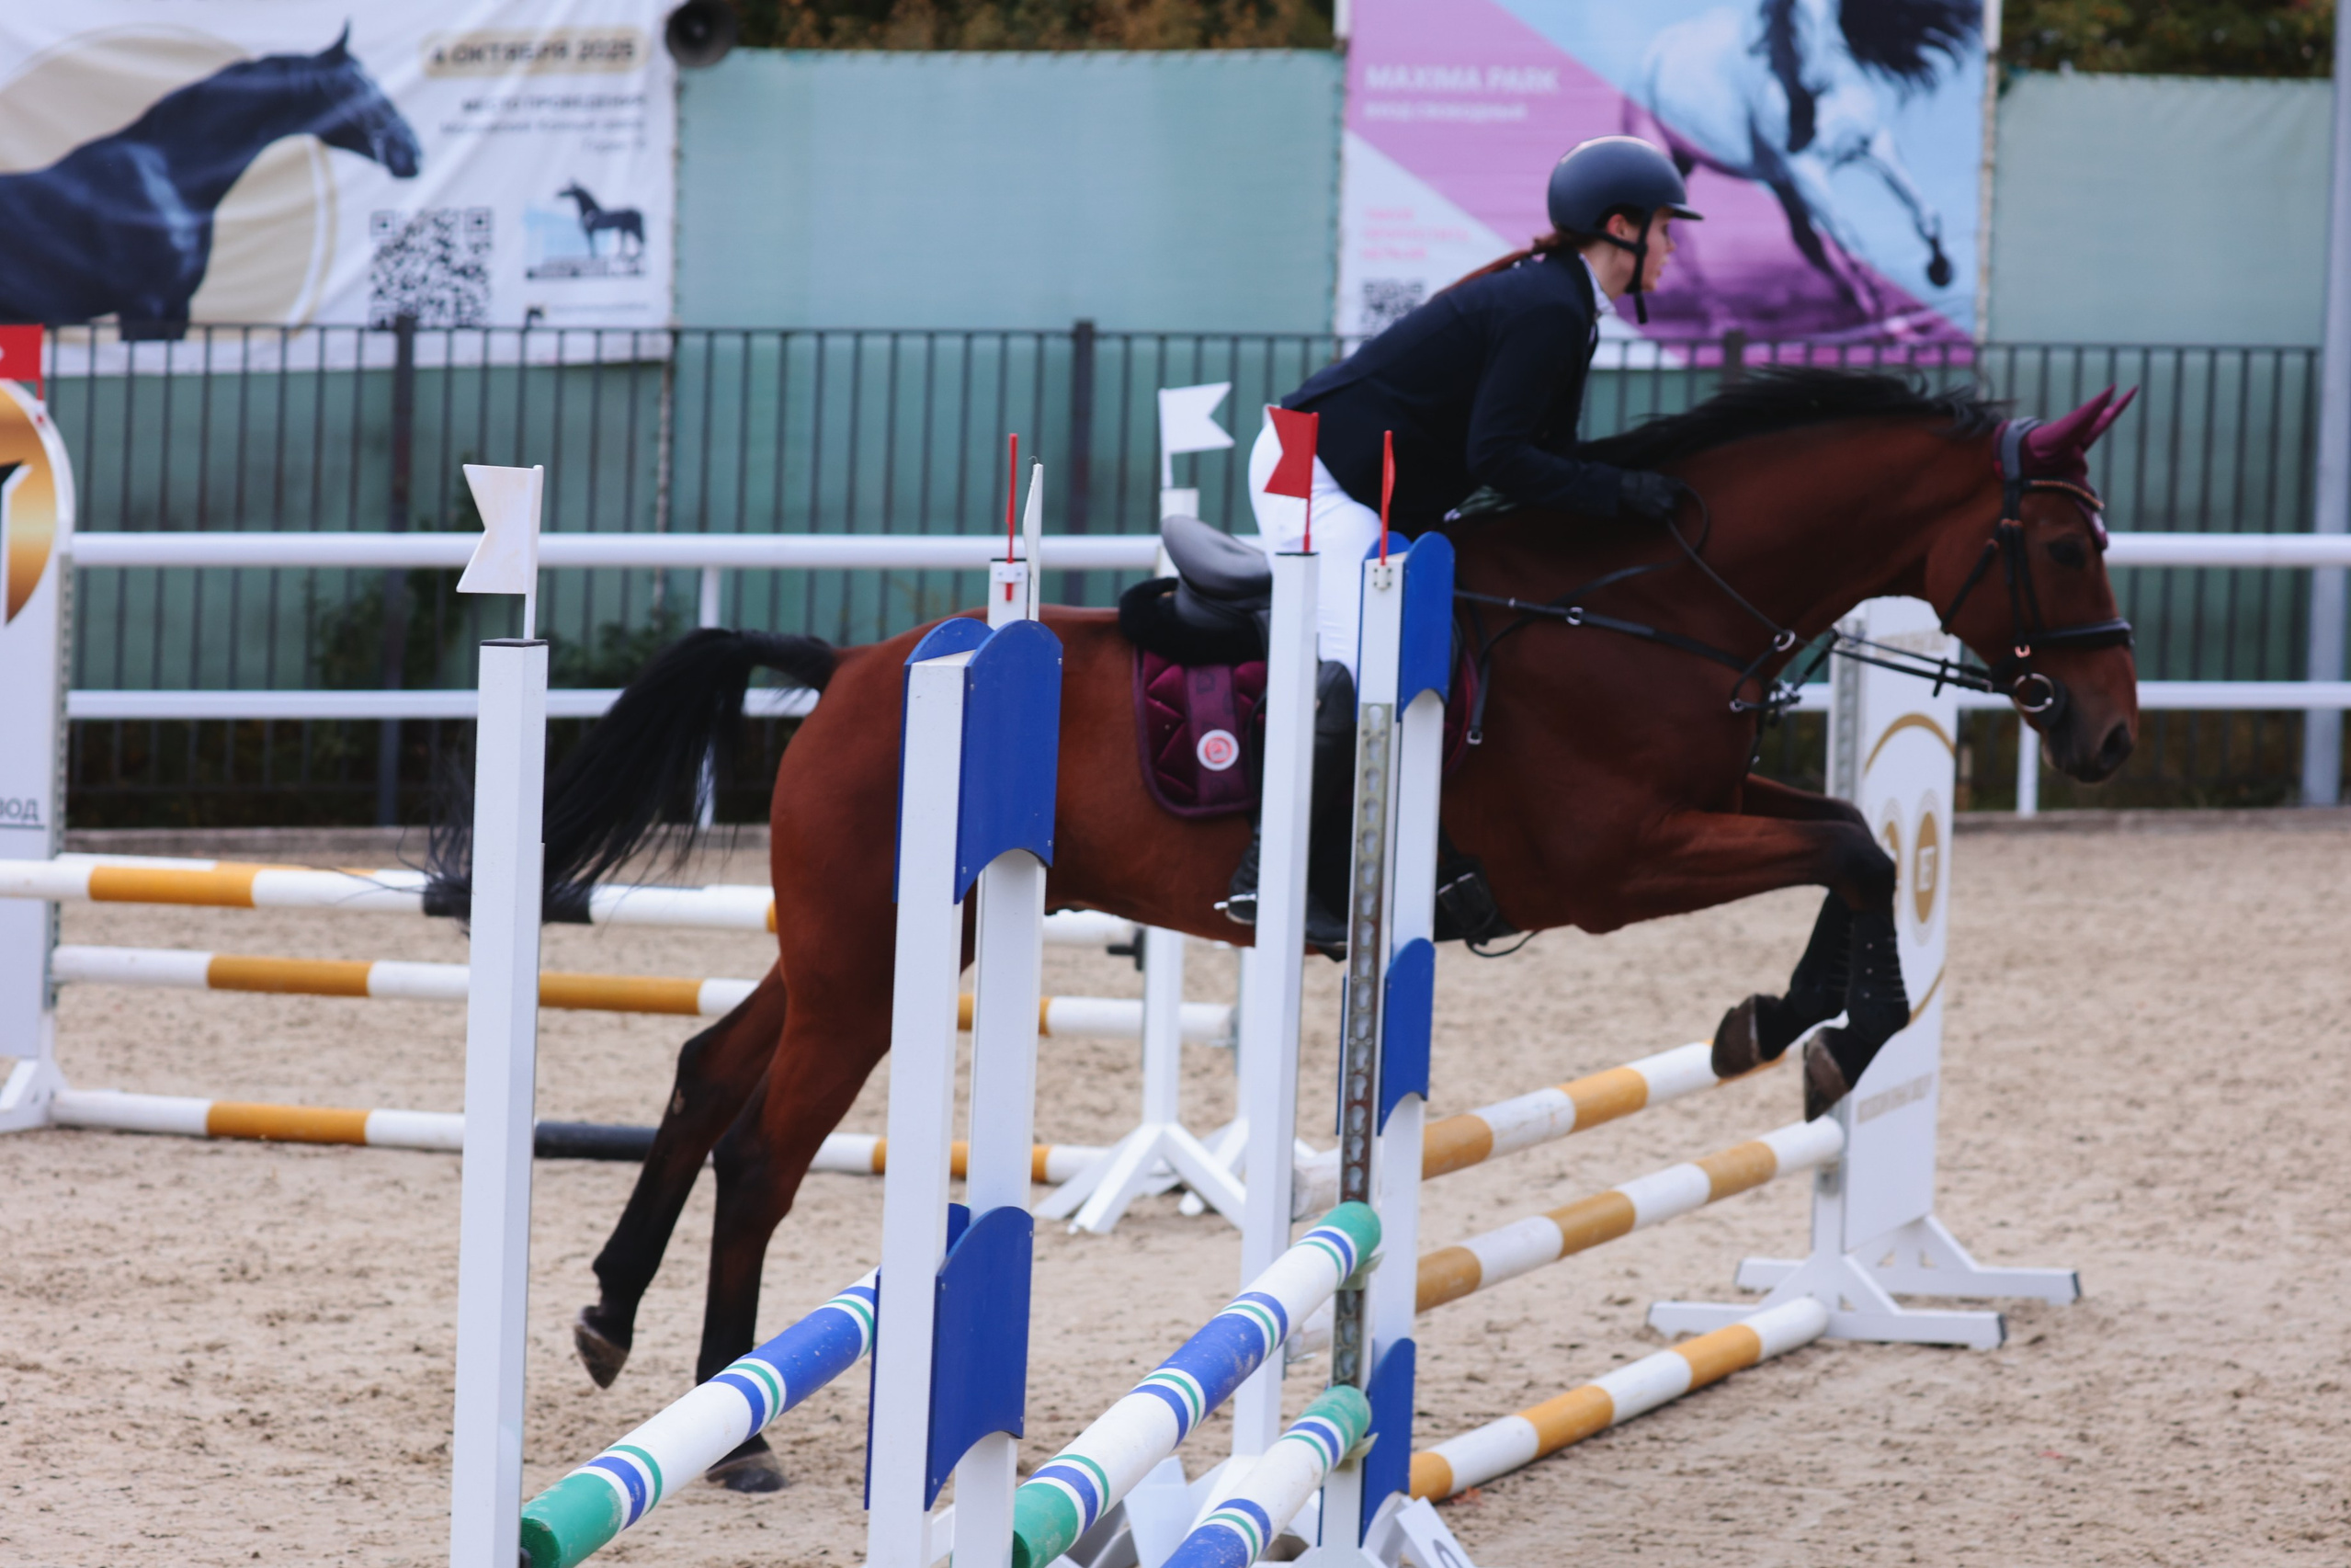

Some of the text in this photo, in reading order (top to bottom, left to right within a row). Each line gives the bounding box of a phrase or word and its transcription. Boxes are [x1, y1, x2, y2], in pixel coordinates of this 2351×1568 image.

[450, 41, 570, 64] ОКТЯБРЯ
[1365, 65, 1560, 93] MAXIMA PARK
